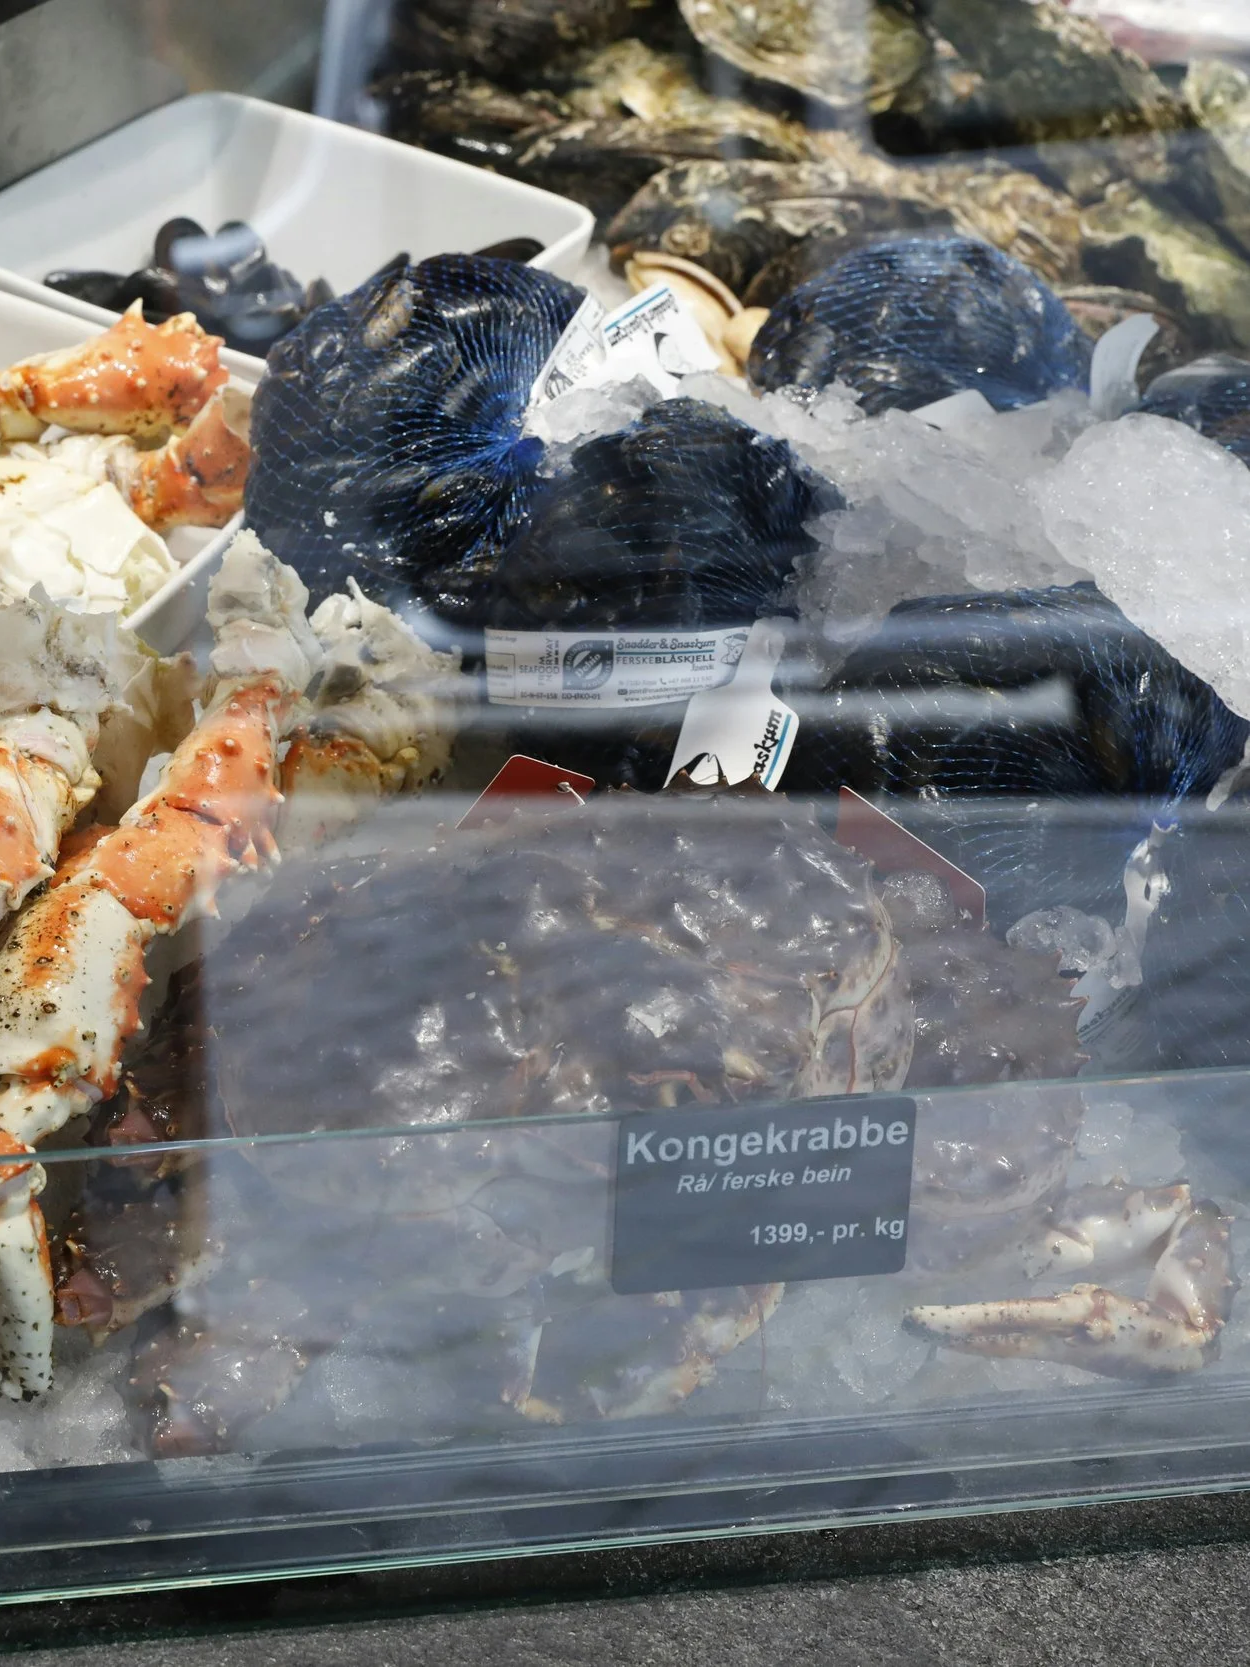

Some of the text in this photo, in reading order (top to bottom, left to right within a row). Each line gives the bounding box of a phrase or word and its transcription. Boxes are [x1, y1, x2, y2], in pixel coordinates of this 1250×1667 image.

[616, 638, 716, 650] Snadder & Snaskum
[519, 664, 560, 674] SEAFOOD
[754, 709, 782, 773] askum
[627, 1115, 909, 1167] Kongekrabbe
[676, 1163, 852, 1194] Rå/ ferske bein
[750, 1216, 905, 1246] 1399,- pr. kg
